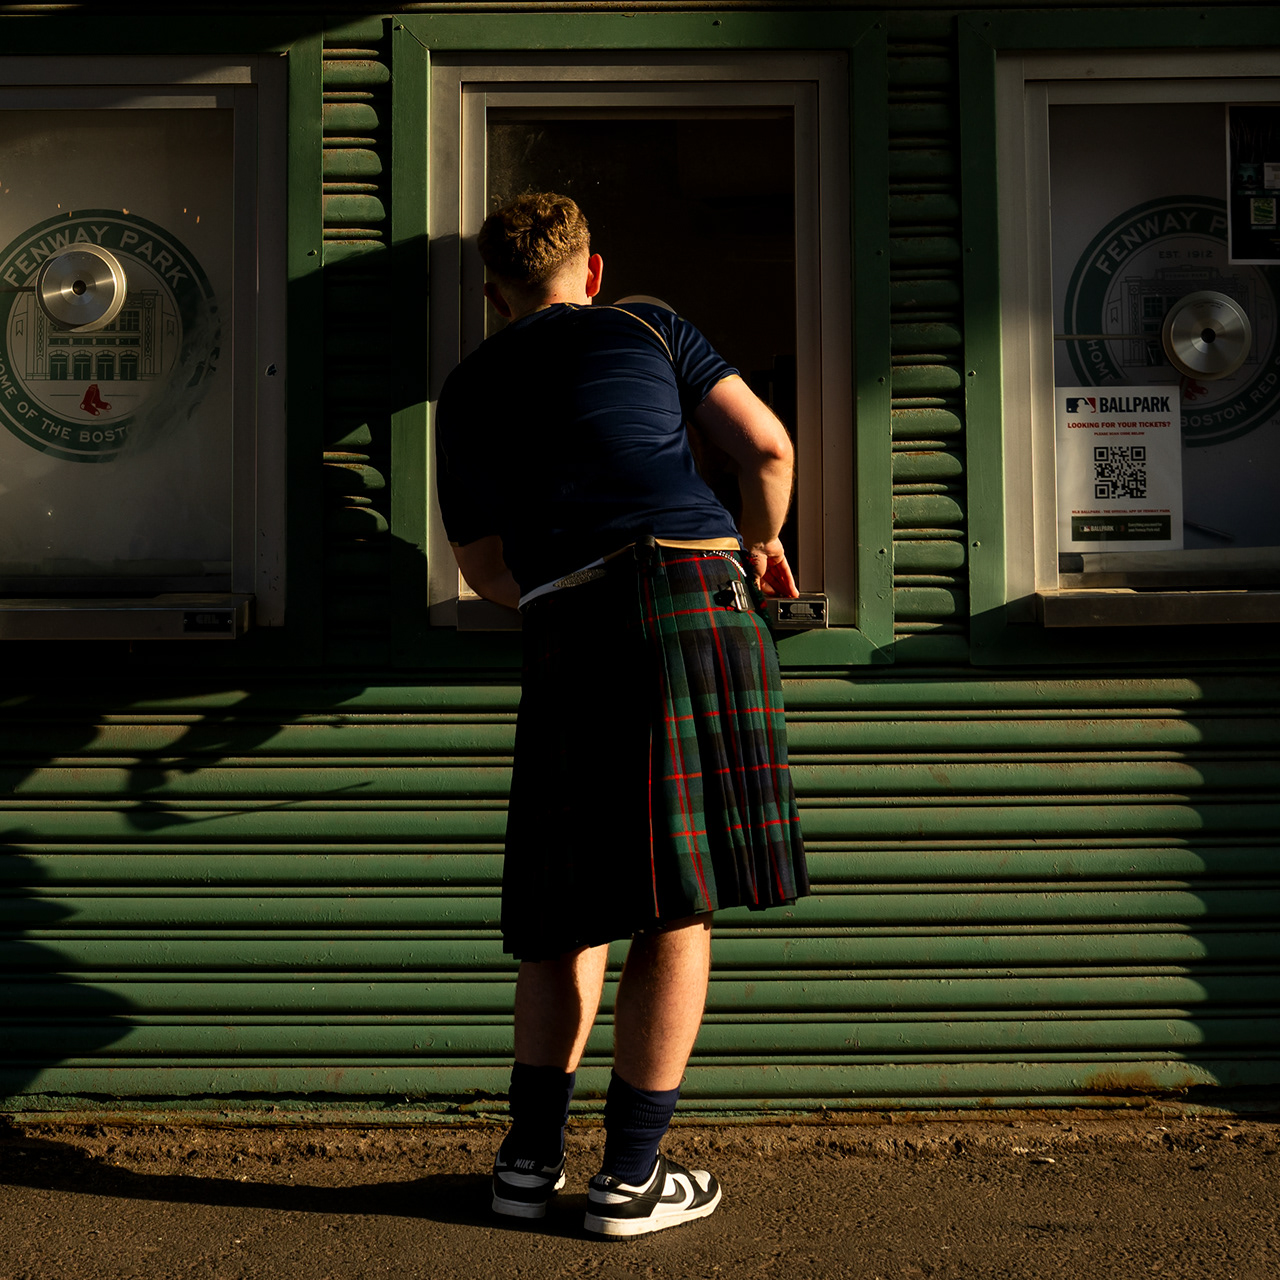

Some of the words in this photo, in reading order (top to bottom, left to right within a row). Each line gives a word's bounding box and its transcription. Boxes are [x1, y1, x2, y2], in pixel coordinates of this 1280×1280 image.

[2, 225, 110, 288] FENWAY
[120, 229, 190, 288] PARK
[1095, 211, 1198, 276] FENWAY
[1158, 250, 1180, 259] EST.
[1187, 249, 1213, 259] 1912
[1249, 372, 1278, 404] RED
[16, 401, 39, 425] OF
[40, 417, 72, 440] THE
[1099, 396, 1171, 413] BALLPARK
[514, 1158, 535, 1170] NIKE
